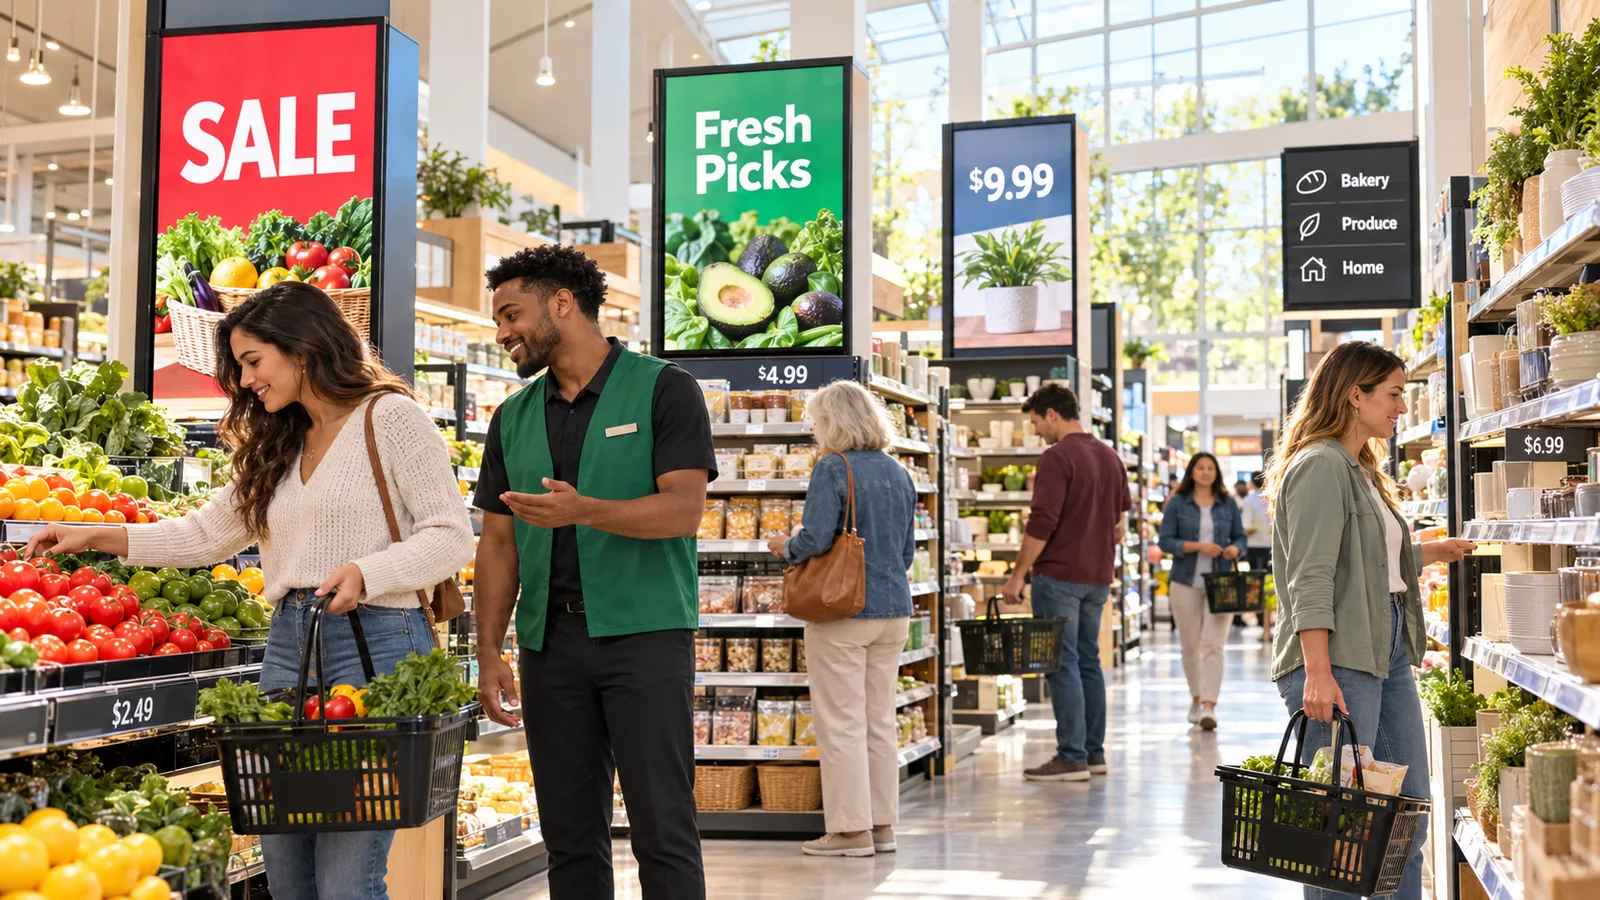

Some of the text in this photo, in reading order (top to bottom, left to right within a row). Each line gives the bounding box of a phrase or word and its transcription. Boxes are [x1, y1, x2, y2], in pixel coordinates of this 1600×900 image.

[180, 92, 355, 184] SALE
[695, 104, 811, 148] Fresh
[696, 150, 811, 195] Picks
[969, 163, 1053, 202] $9.99
[1341, 173, 1390, 190] Bakery
[1342, 215, 1398, 231] Produce
[1342, 260, 1385, 275] Home
[758, 364, 808, 385] $4.99
[1524, 435, 1564, 456] $6.99
[112, 696, 153, 728] $2.49
